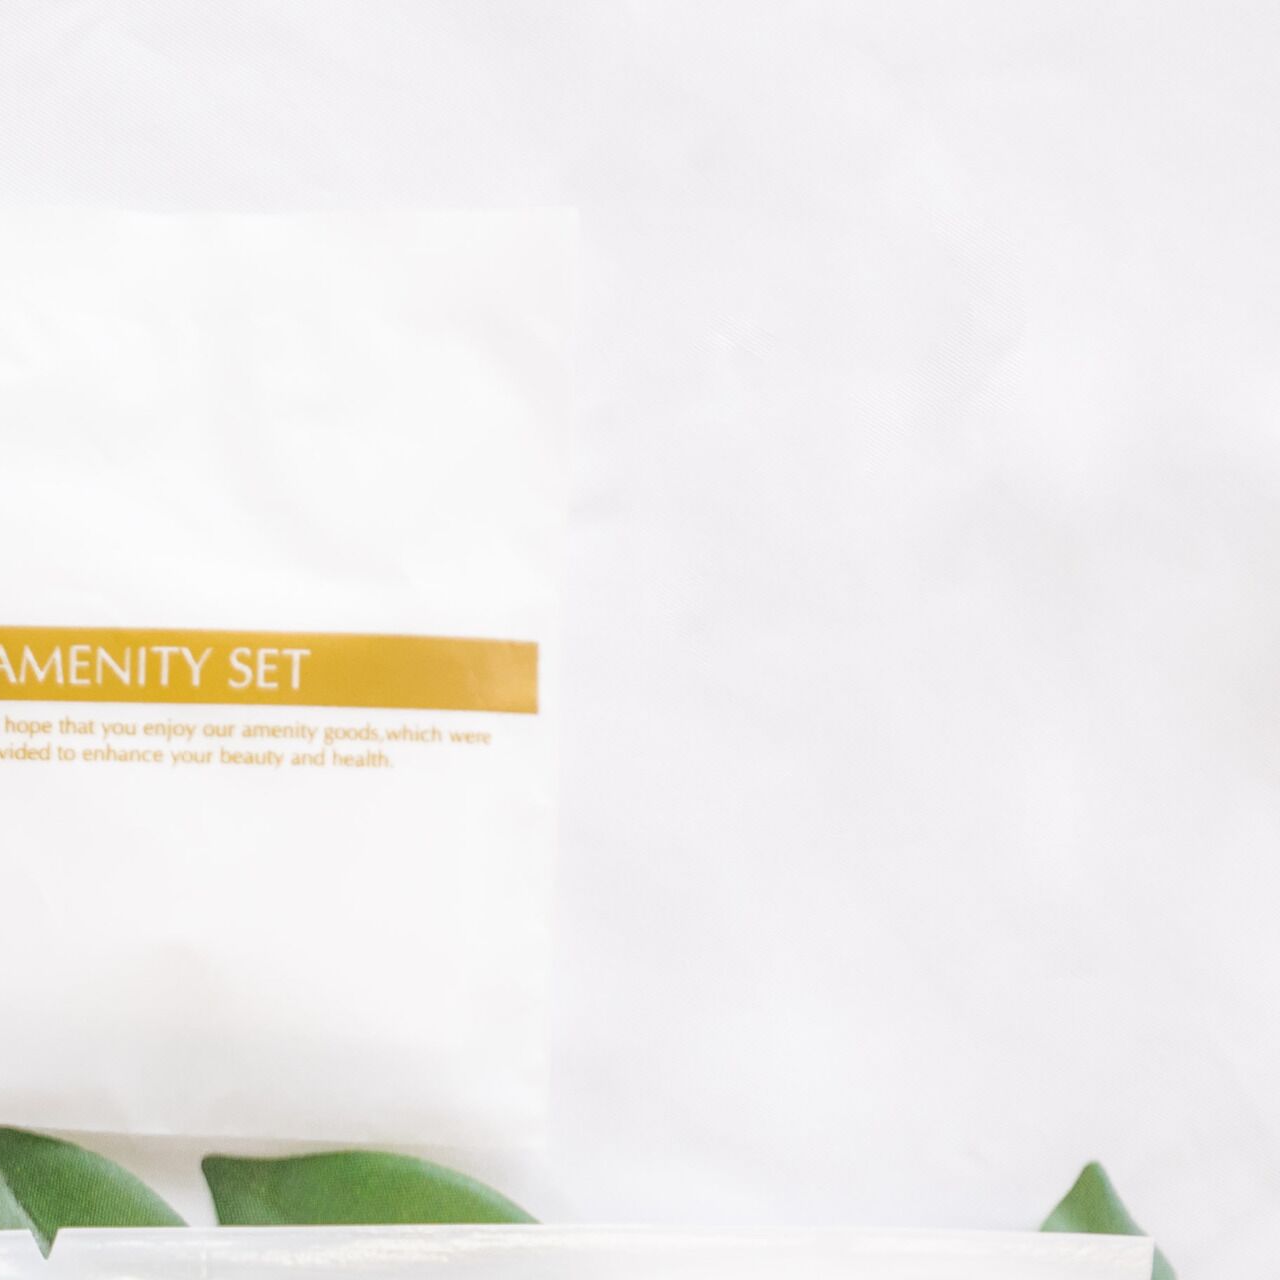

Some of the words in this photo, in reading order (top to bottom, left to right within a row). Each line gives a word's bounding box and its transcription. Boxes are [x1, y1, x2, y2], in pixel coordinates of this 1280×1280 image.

[227, 646, 312, 690] SET
[4, 714, 53, 738] hope
[59, 716, 94, 735] that
[101, 722, 137, 740] you
[142, 720, 197, 741] enjoy
[202, 723, 237, 737] our
[241, 723, 319, 744] amenity
[448, 731, 493, 746] were
[56, 746, 77, 762] to
[81, 744, 163, 765] enhance
[171, 751, 213, 768] your
[220, 747, 284, 770] beauty
[290, 748, 326, 768] and
[332, 750, 395, 770] health.
